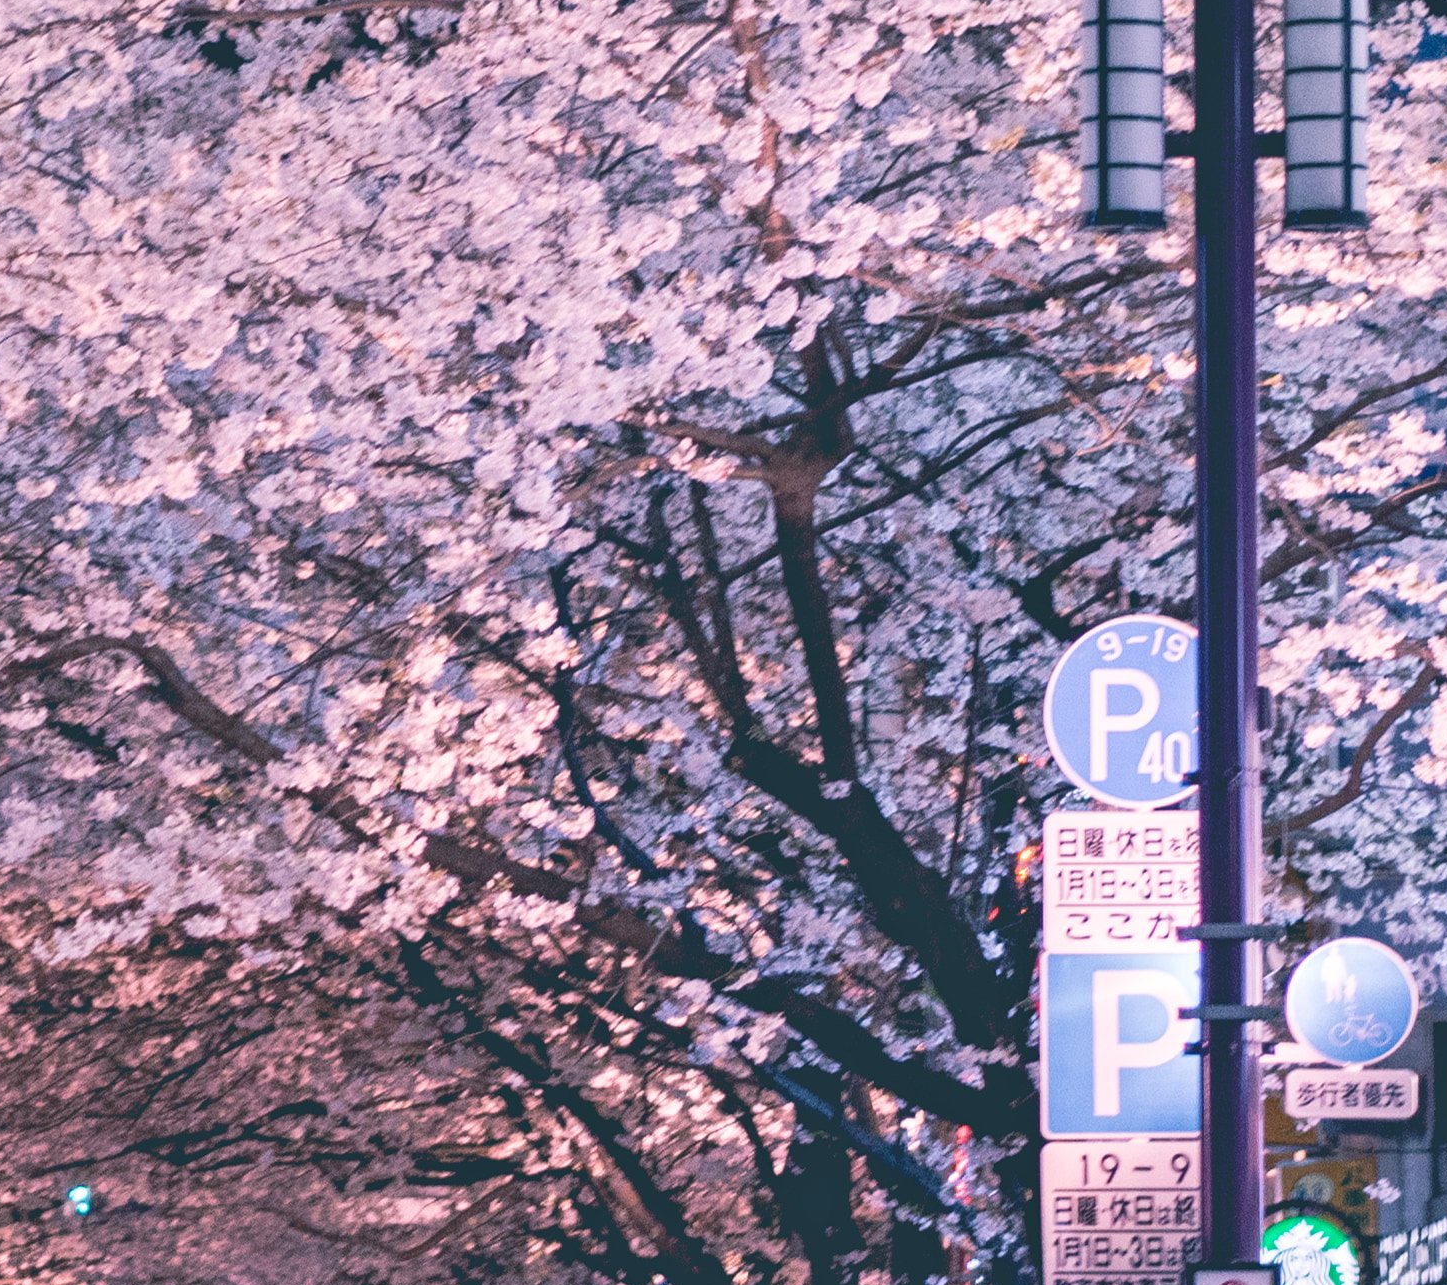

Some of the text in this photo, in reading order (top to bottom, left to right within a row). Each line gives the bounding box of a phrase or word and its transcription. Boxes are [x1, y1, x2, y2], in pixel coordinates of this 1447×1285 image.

[1095, 626, 1190, 663] 9-19
[1090, 668, 1160, 782] P
[1137, 730, 1192, 784] 40
[1092, 969, 1195, 1117] P
[1297, 1080, 1407, 1109] 歩行者優先
